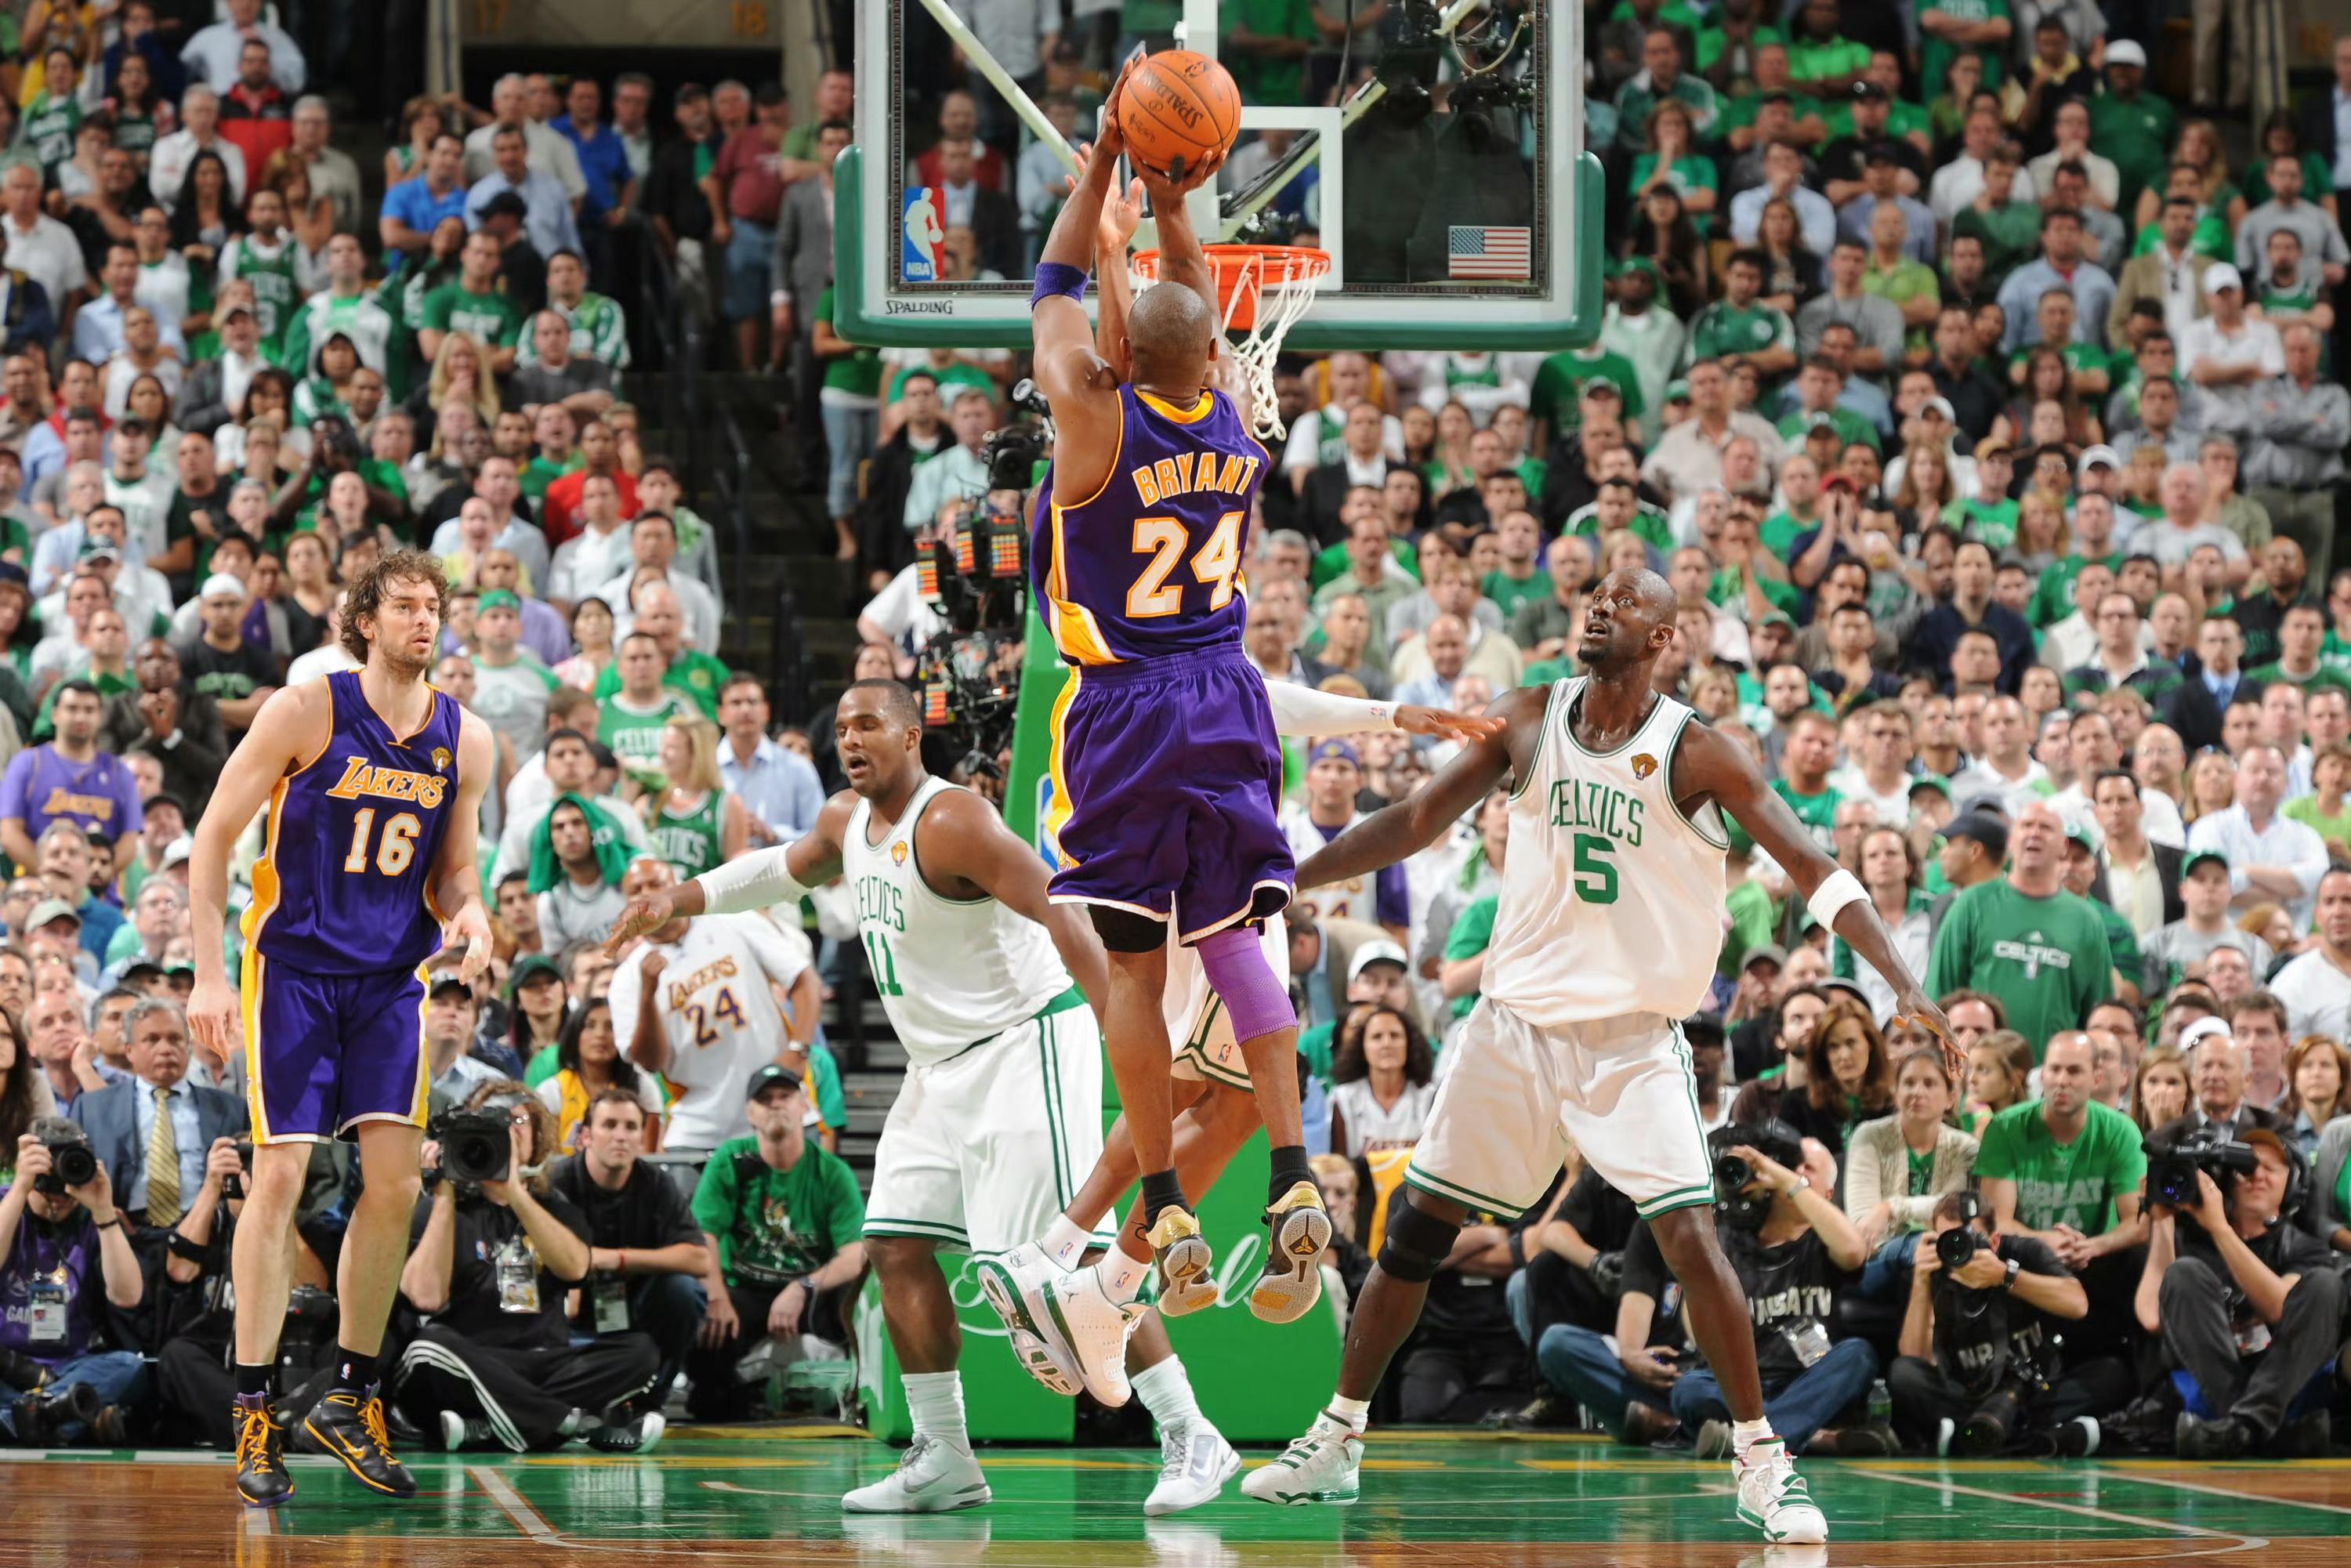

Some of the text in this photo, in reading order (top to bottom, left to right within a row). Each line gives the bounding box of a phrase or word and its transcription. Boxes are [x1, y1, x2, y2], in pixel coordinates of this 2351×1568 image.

[906, 262, 930, 276] NBA
[886, 299, 953, 314] SPALDING
[1132, 451, 1259, 508] BRYANT
[1125, 511, 1245, 618] 24
[325, 755, 448, 809] LAKERS
[344, 807, 422, 877] 16
[1550, 779, 1645, 847] CELTICS
[1574, 832, 1619, 905] 5
[668, 954, 739, 1012] LAKERS
[867, 931, 904, 996] 11
[1993, 940, 2071, 969] CELTICS
[684, 984, 746, 1048] 24
[1801, 1286, 1832, 1316] TV
